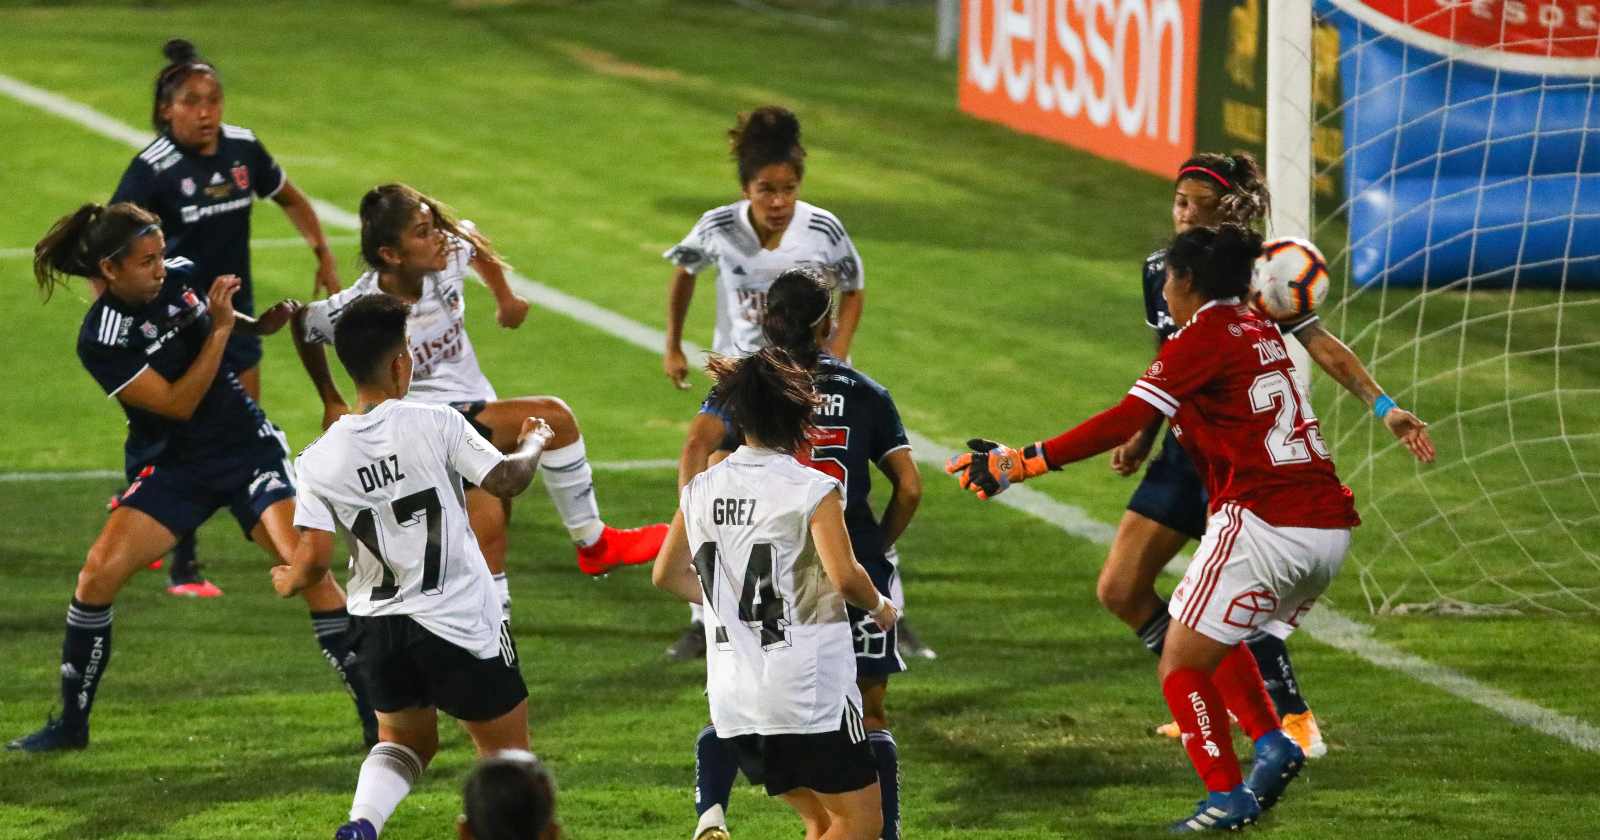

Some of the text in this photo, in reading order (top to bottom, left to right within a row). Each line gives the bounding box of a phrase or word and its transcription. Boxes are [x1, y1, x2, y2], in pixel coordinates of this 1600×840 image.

[1437, 0, 1599, 29] ESDE
[357, 454, 405, 493] DIAZ
[713, 498, 757, 526] GREZ
[351, 486, 449, 606] 17
[693, 541, 792, 651] 14
[82, 636, 104, 688] VISION
[1187, 691, 1212, 740] VISION
